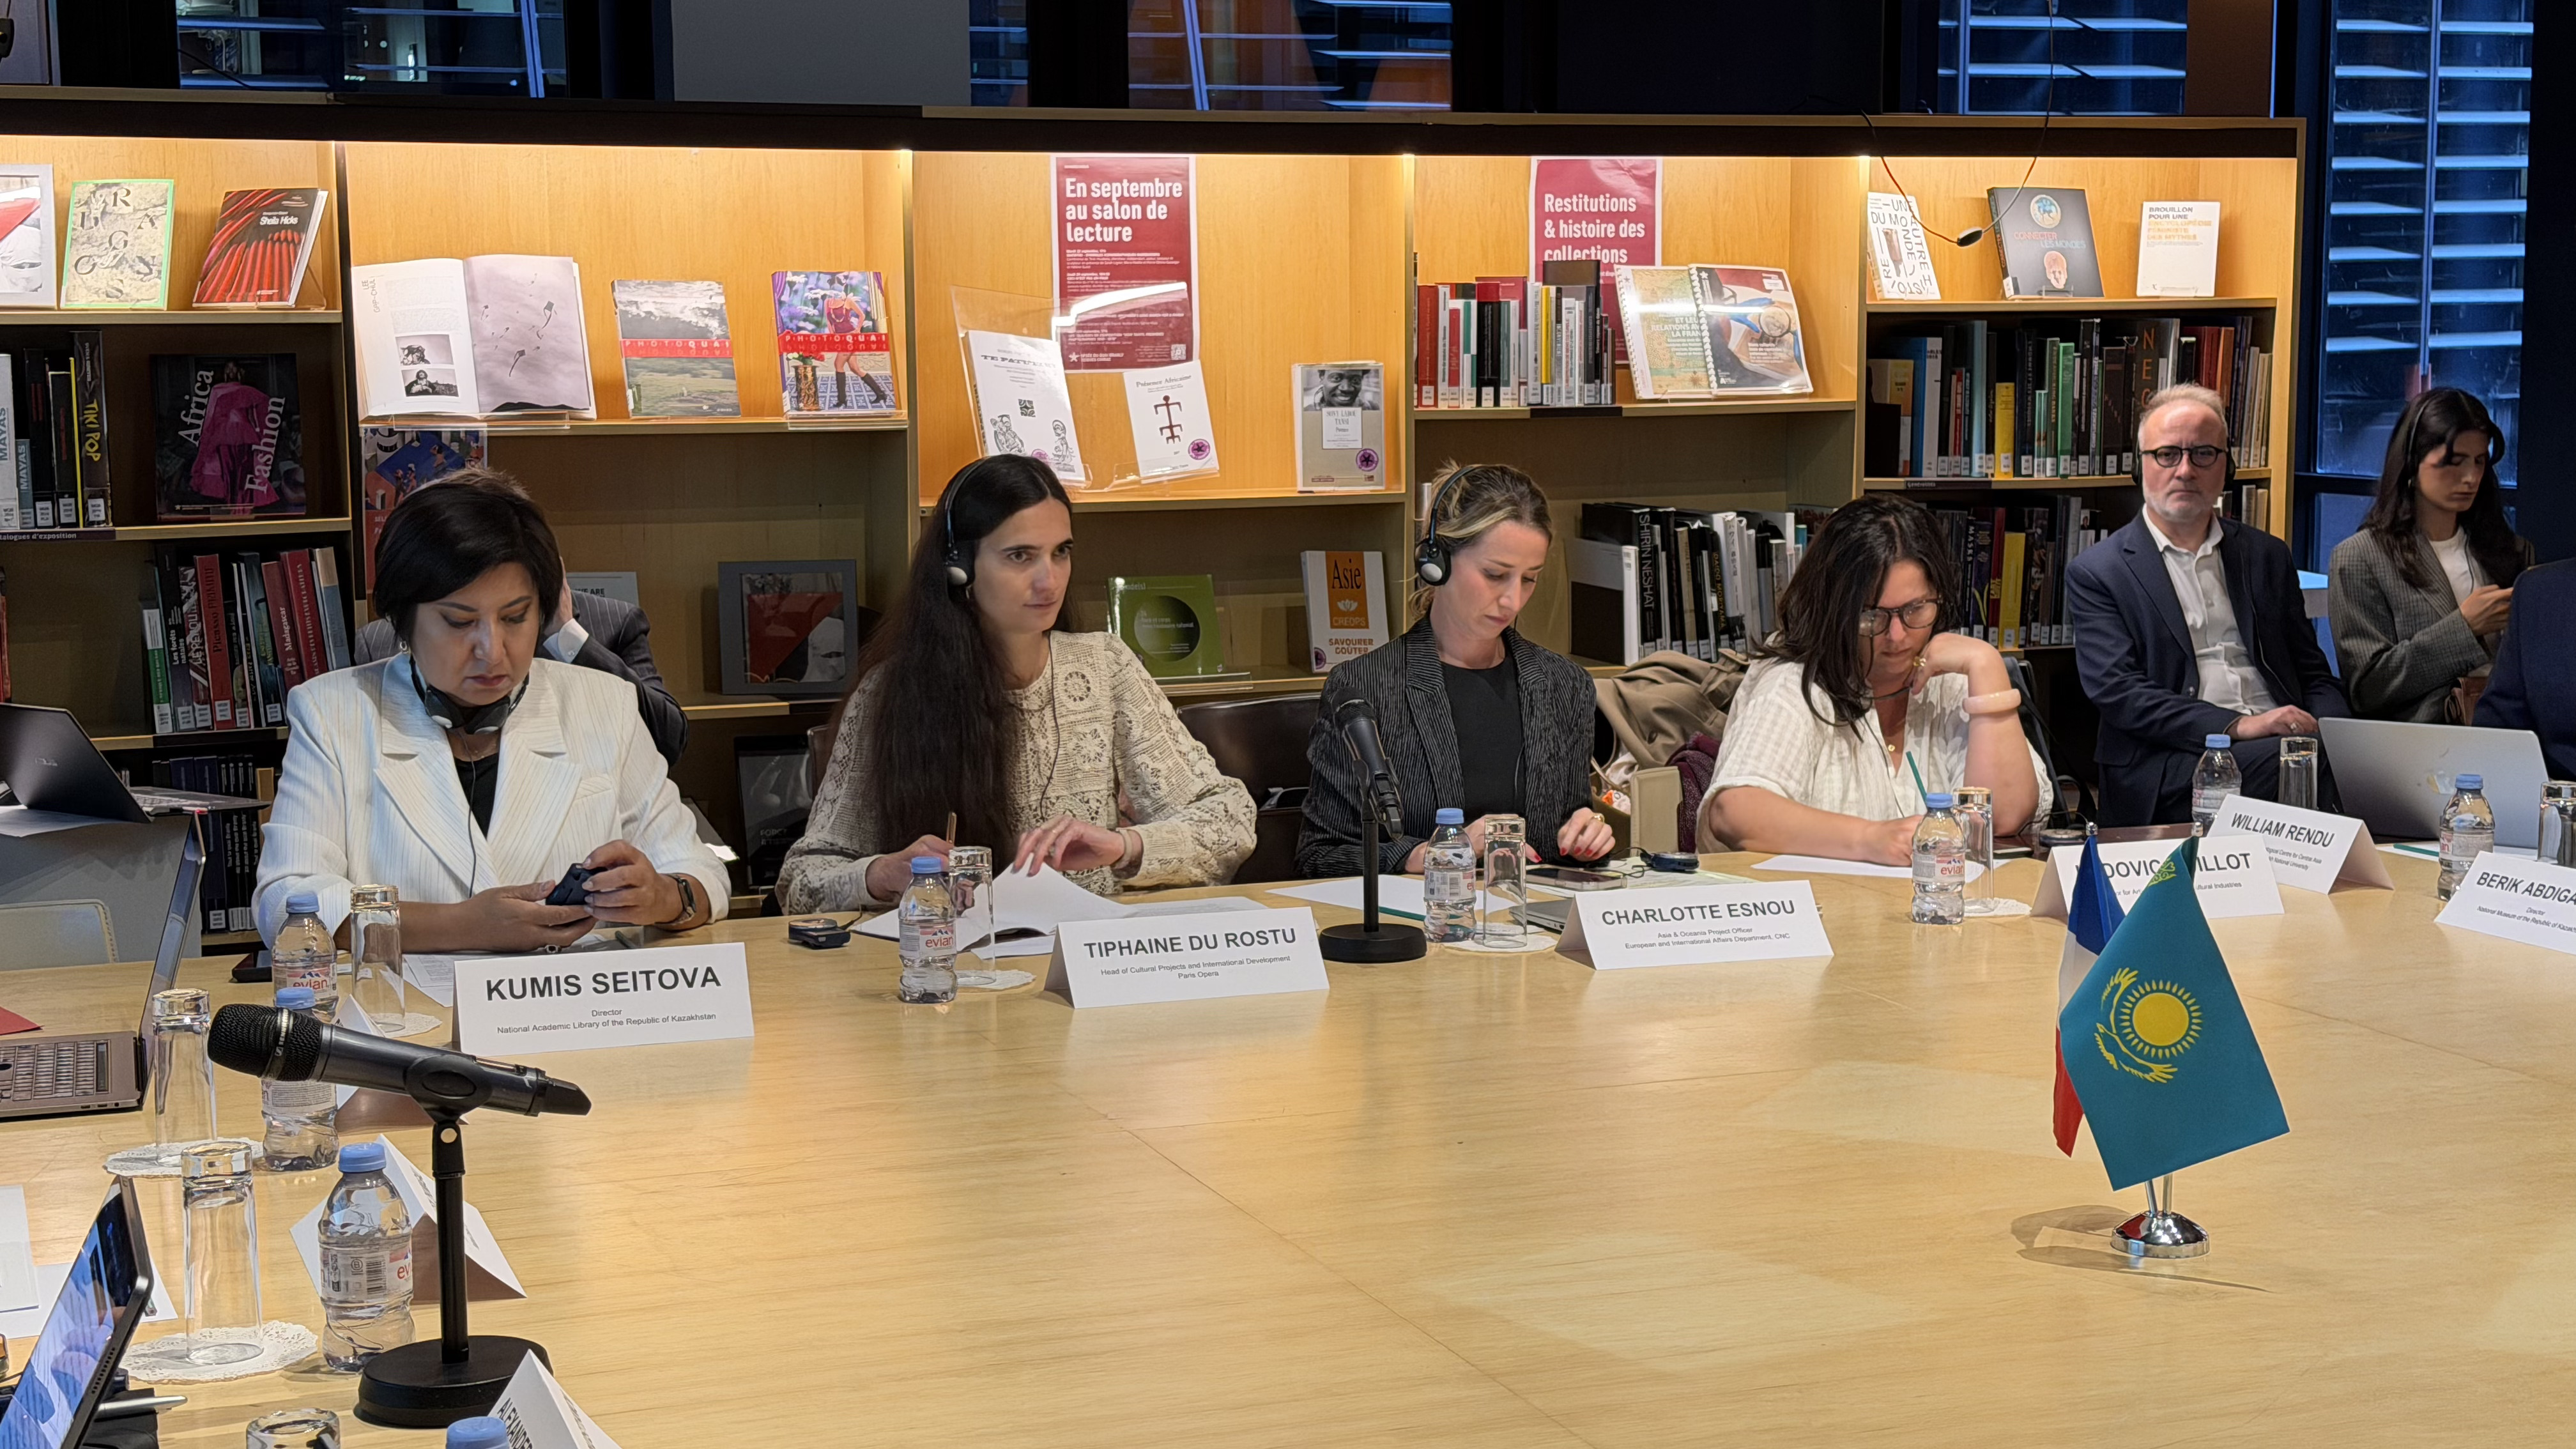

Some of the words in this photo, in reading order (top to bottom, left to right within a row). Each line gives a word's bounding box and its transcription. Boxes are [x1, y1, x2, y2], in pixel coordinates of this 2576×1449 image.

[1066, 178, 1086, 197] En
[1091, 178, 1182, 203] septembre
[1066, 204, 1087, 220] au
[1092, 201, 1142, 220] salon
[1147, 200, 1167, 220] de
[1544, 194, 1636, 213] Restitutions
[1544, 220, 1555, 238] &
[1560, 219, 1616, 238] histoire
[1619, 219, 1645, 238] des
[1871, 211, 1885, 224] DU
[1066, 222, 1132, 241] lecture
[1544, 245, 1628, 263] collections
[625, 340, 730, 349] PHOTOQUAI
[785, 334, 887, 343] PHOTOQUAI
[84, 399, 100, 429] TIKI
[178, 369, 214, 447] Africa
[85, 432, 101, 461] POP
[245, 396, 285, 494] Fashion
[19, 445, 29, 491] MAYAS
[32, 532, 77, 540] d'exposition
[1639, 514, 1652, 558] SHIRIN
[1332, 558, 1362, 589] Asie
[1642, 560, 1655, 609] NESHAT
[280, 606, 293, 651] Madagascar
[1333, 617, 1365, 626] CREOPS
[211, 612, 222, 654] Picasso
[2231, 813, 2286, 837] WILLIAM
[2285, 825, 2334, 847] RENDU
[2076, 859, 2161, 878] DOVIC
[2195, 853, 2251, 872] ILLOT
[2476, 871, 2524, 894] BERIK
[1602, 904, 1722, 925] CHARLOTTE
[1726, 900, 1795, 918] ESNOU
[925, 935, 953, 947] evian
[1084, 937, 1182, 958] TIPHAINE
[1188, 933, 1218, 951] DU
[1224, 928, 1296, 948] ROSTU
[1625, 941, 1657, 950] European
[1672, 937, 1711, 946] International
[1775, 932, 1790, 940] CNC
[1708, 928, 1730, 937] Project
[1101, 967, 1119, 976] Head
[1121, 967, 1128, 975] of
[1130, 964, 1156, 974] Cultural
[1158, 963, 1186, 972] Projects
[1188, 962, 1200, 970] and
[1202, 958, 1245, 969] International
[1246, 954, 1291, 966] Development
[1197, 970, 1219, 979] Opera
[292, 977, 328, 990] evian
[486, 974, 583, 1001] KUMIS
[592, 966, 721, 995] SEITOVA
[497, 1025, 530, 1034] National
[532, 1022, 571, 1032] Academic
[572, 1020, 599, 1031] Library
[602, 1018, 610, 1027] of
[611, 1018, 624, 1027] the
[625, 1015, 660, 1027] Republic
[662, 1015, 670, 1023] of
[671, 1012, 716, 1022] Kazakhstan
[592, 1008, 622, 1017] Director
